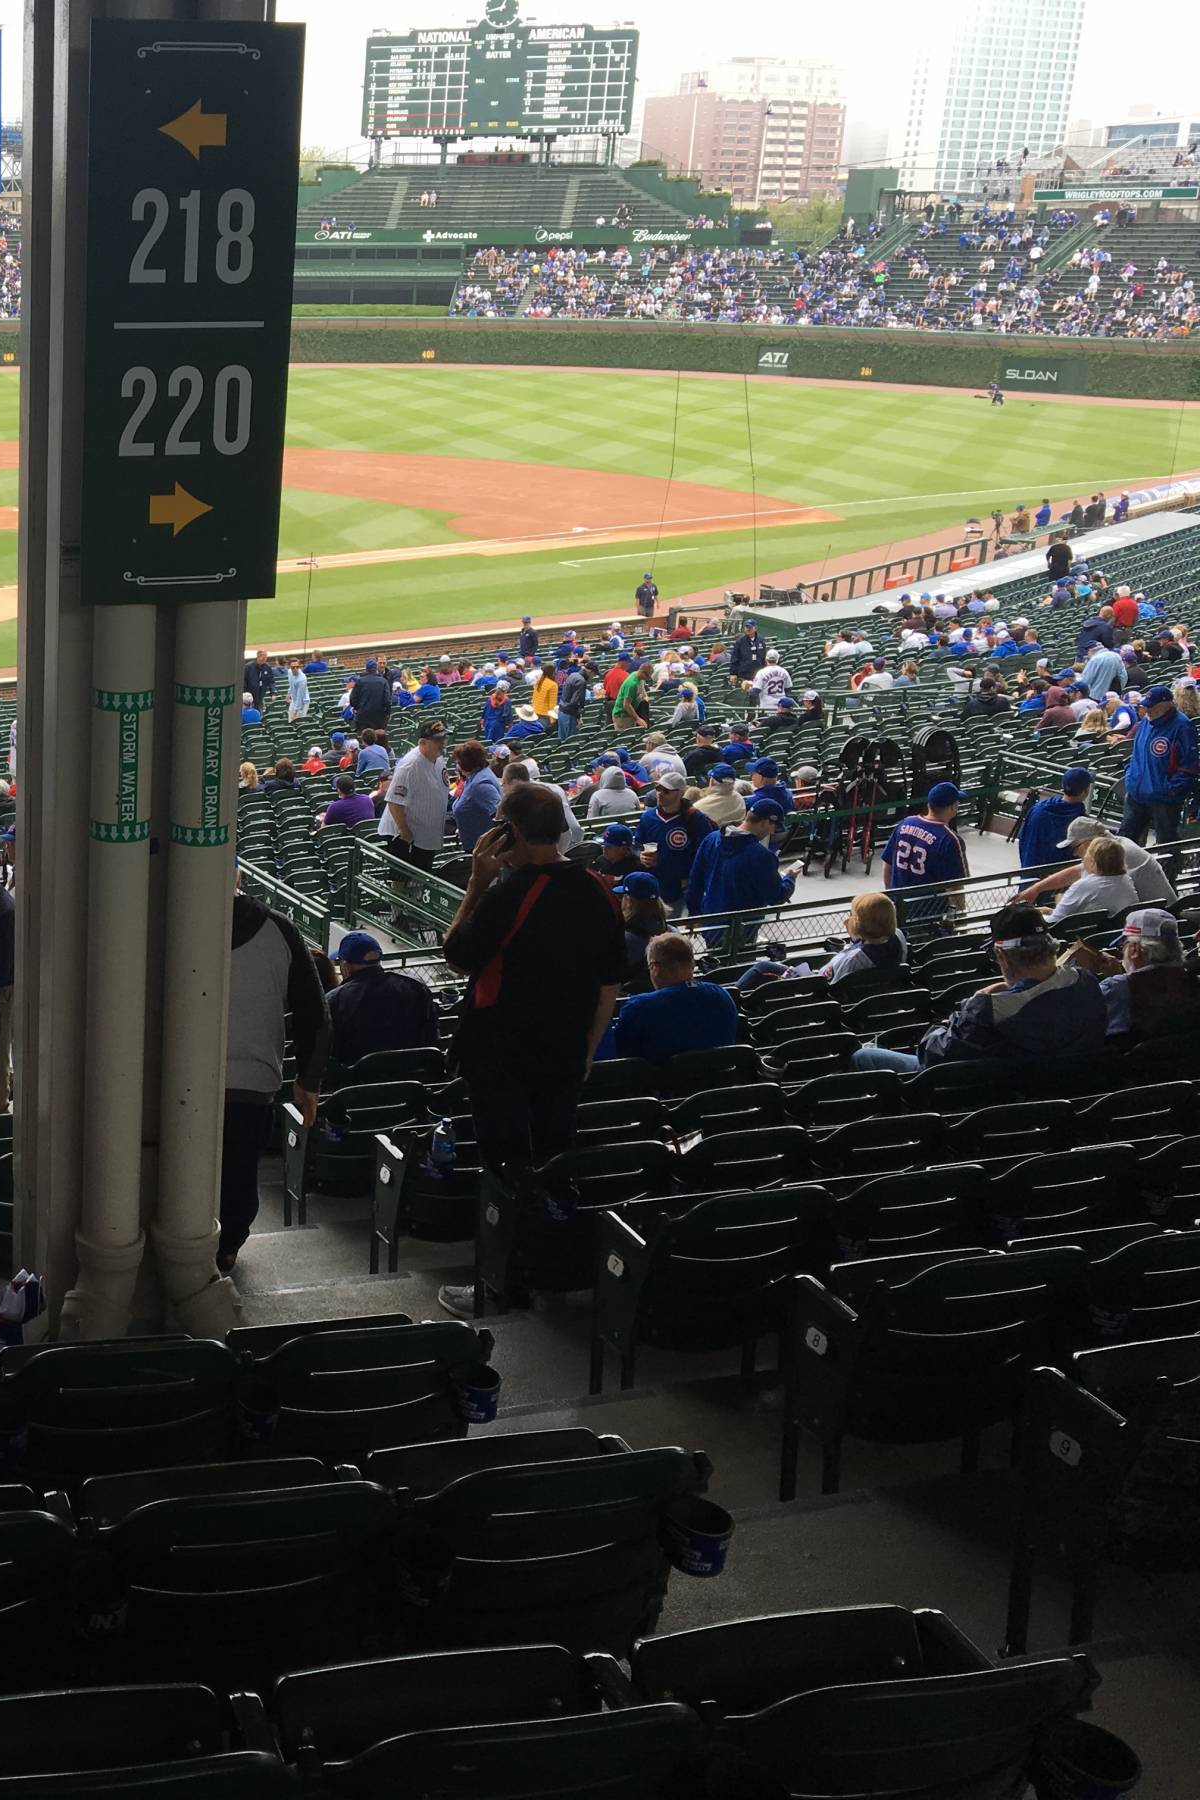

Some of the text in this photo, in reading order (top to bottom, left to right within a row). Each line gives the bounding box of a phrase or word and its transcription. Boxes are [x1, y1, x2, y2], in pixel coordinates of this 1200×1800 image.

[417, 31, 472, 43] NATIONAL
[528, 27, 585, 40] AMERICAN
[1064, 189, 1163, 200] WRIGLEYROOFTOPS.COM
[128, 187, 256, 285] 218
[329, 231, 352, 240] ATI
[435, 231, 478, 240] Advocate
[548, 231, 573, 241] pepsi
[632, 229, 692, 242] Budweiser
[759, 351, 789, 364] ATI
[1005, 368, 1058, 382] SLOAN
[117, 363, 253, 457] 220
[767, 680, 785, 695] 23
[121, 712, 137, 822] STORM WATER
[204, 707, 221, 828] SANITARY DRAIN
[900, 824, 937, 846] SANDBERG
[896, 839, 928, 876] 23
[812, 1334, 820, 1347] 8
[1060, 1440, 1070, 1455] 9
